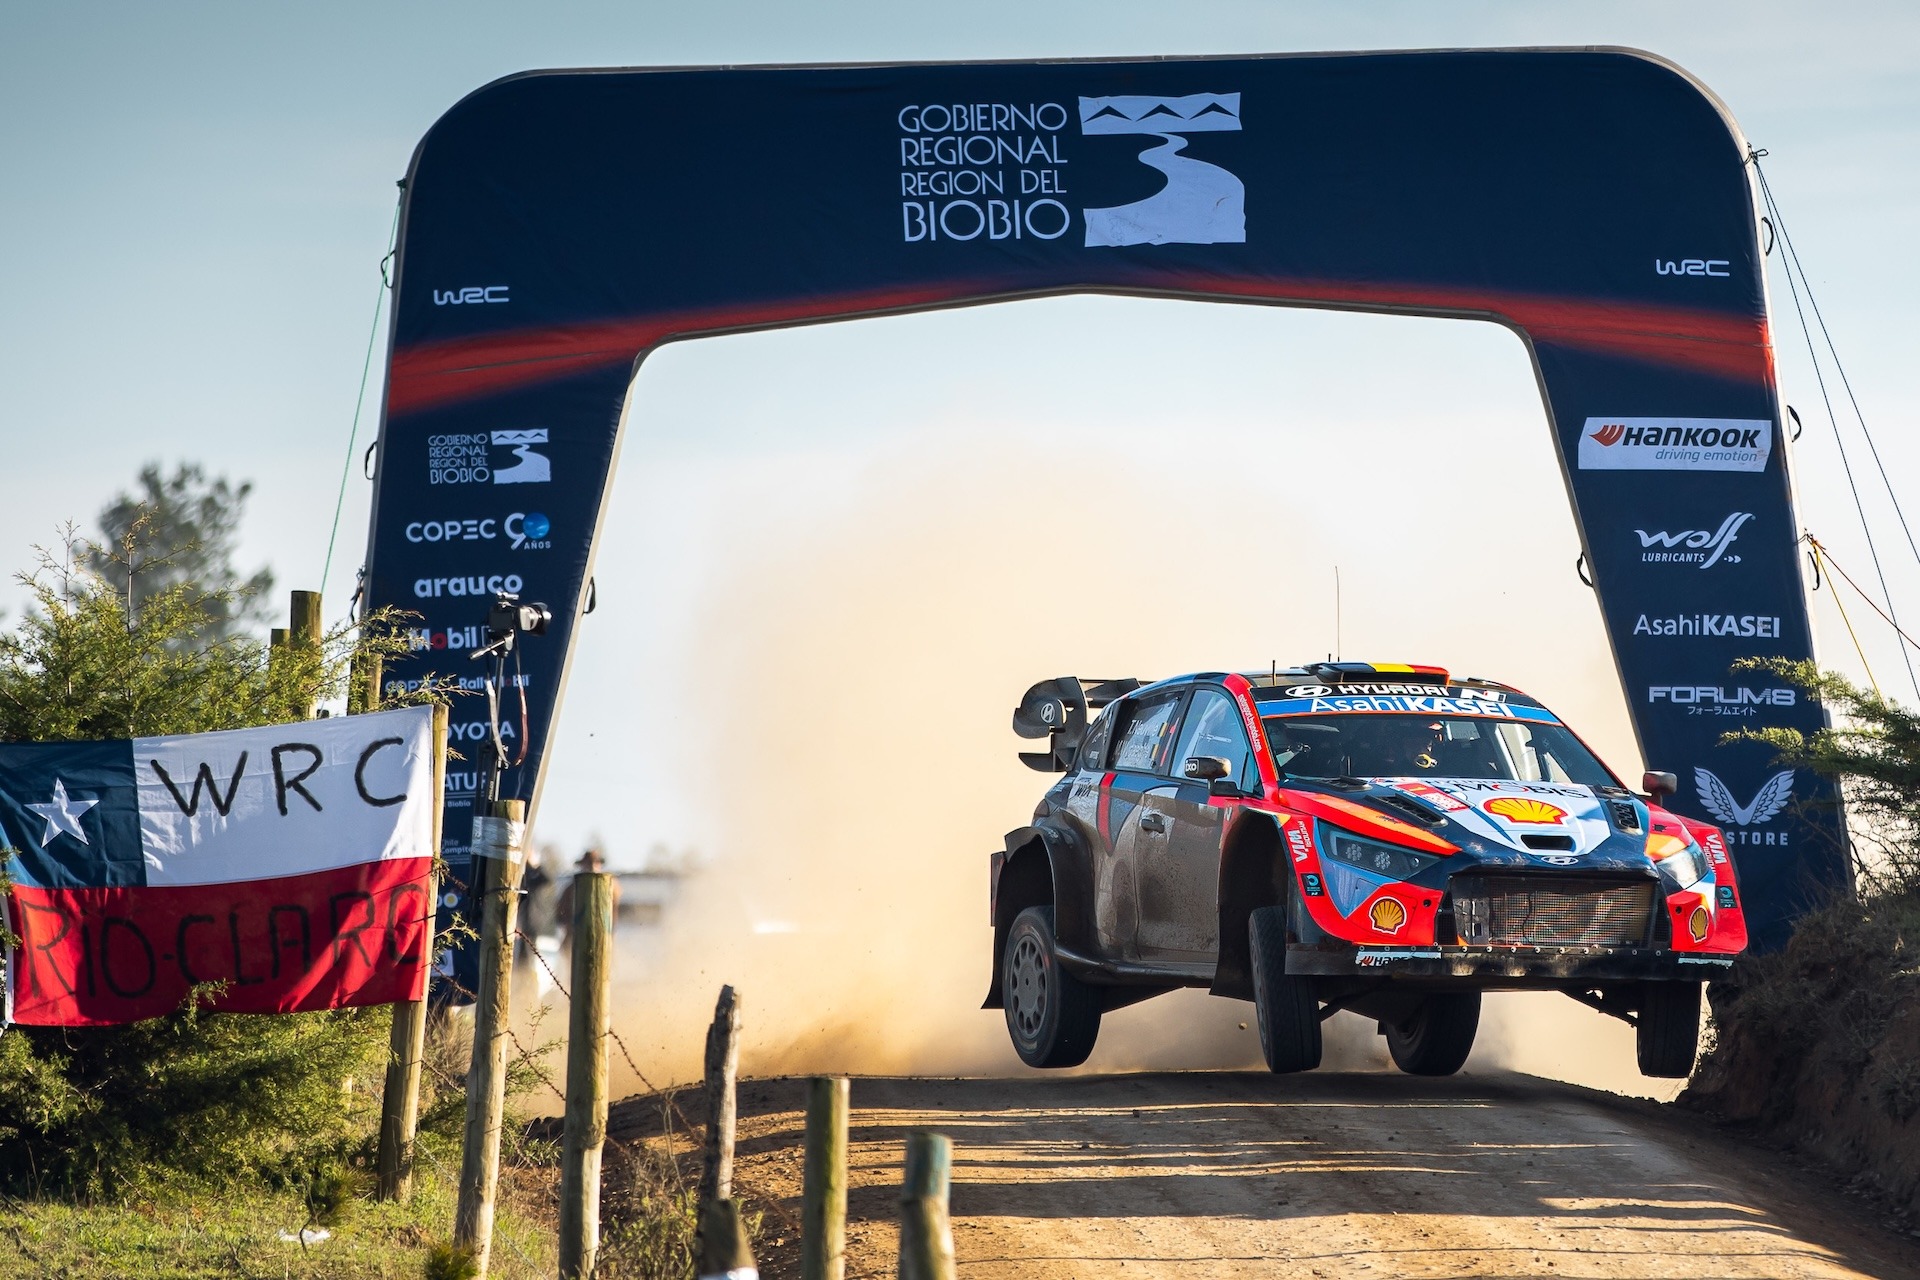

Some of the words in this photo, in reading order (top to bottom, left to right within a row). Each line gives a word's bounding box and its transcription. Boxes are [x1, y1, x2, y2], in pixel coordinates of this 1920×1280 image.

[898, 103, 1067, 133] GOBIERNO
[900, 135, 1068, 167] REGIONAL
[900, 170, 1004, 196] REGION
[1020, 169, 1067, 195] DEL
[903, 198, 1070, 242] BIOBIO
[1656, 258, 1730, 277] WRC
[433, 286, 510, 306] WRC
[428, 432, 488, 447] GOBIERNO
[428, 445, 488, 458] REGIONAL
[1655, 449, 1699, 463] driving
[1703, 450, 1758, 463] emotion
[429, 457, 466, 469] REGION
[470, 456, 488, 467] DEL
[430, 467, 490, 485] BIOBIO
[405, 518, 497, 543] COPEC
[523, 540, 551, 550] AÑOS
[1641, 552, 1705, 563] LUBRICANTS
[413, 574, 523, 598] arauco
[408, 625, 478, 652] Mobil
[1339, 684, 1450, 697] HYUNDAI
[1648, 686, 1796, 706] FORUM8
[1687, 705, 1757, 716] フォーラムエイト
[150, 737, 408, 817] WRC
[1454, 783, 1589, 799] MOBIS
